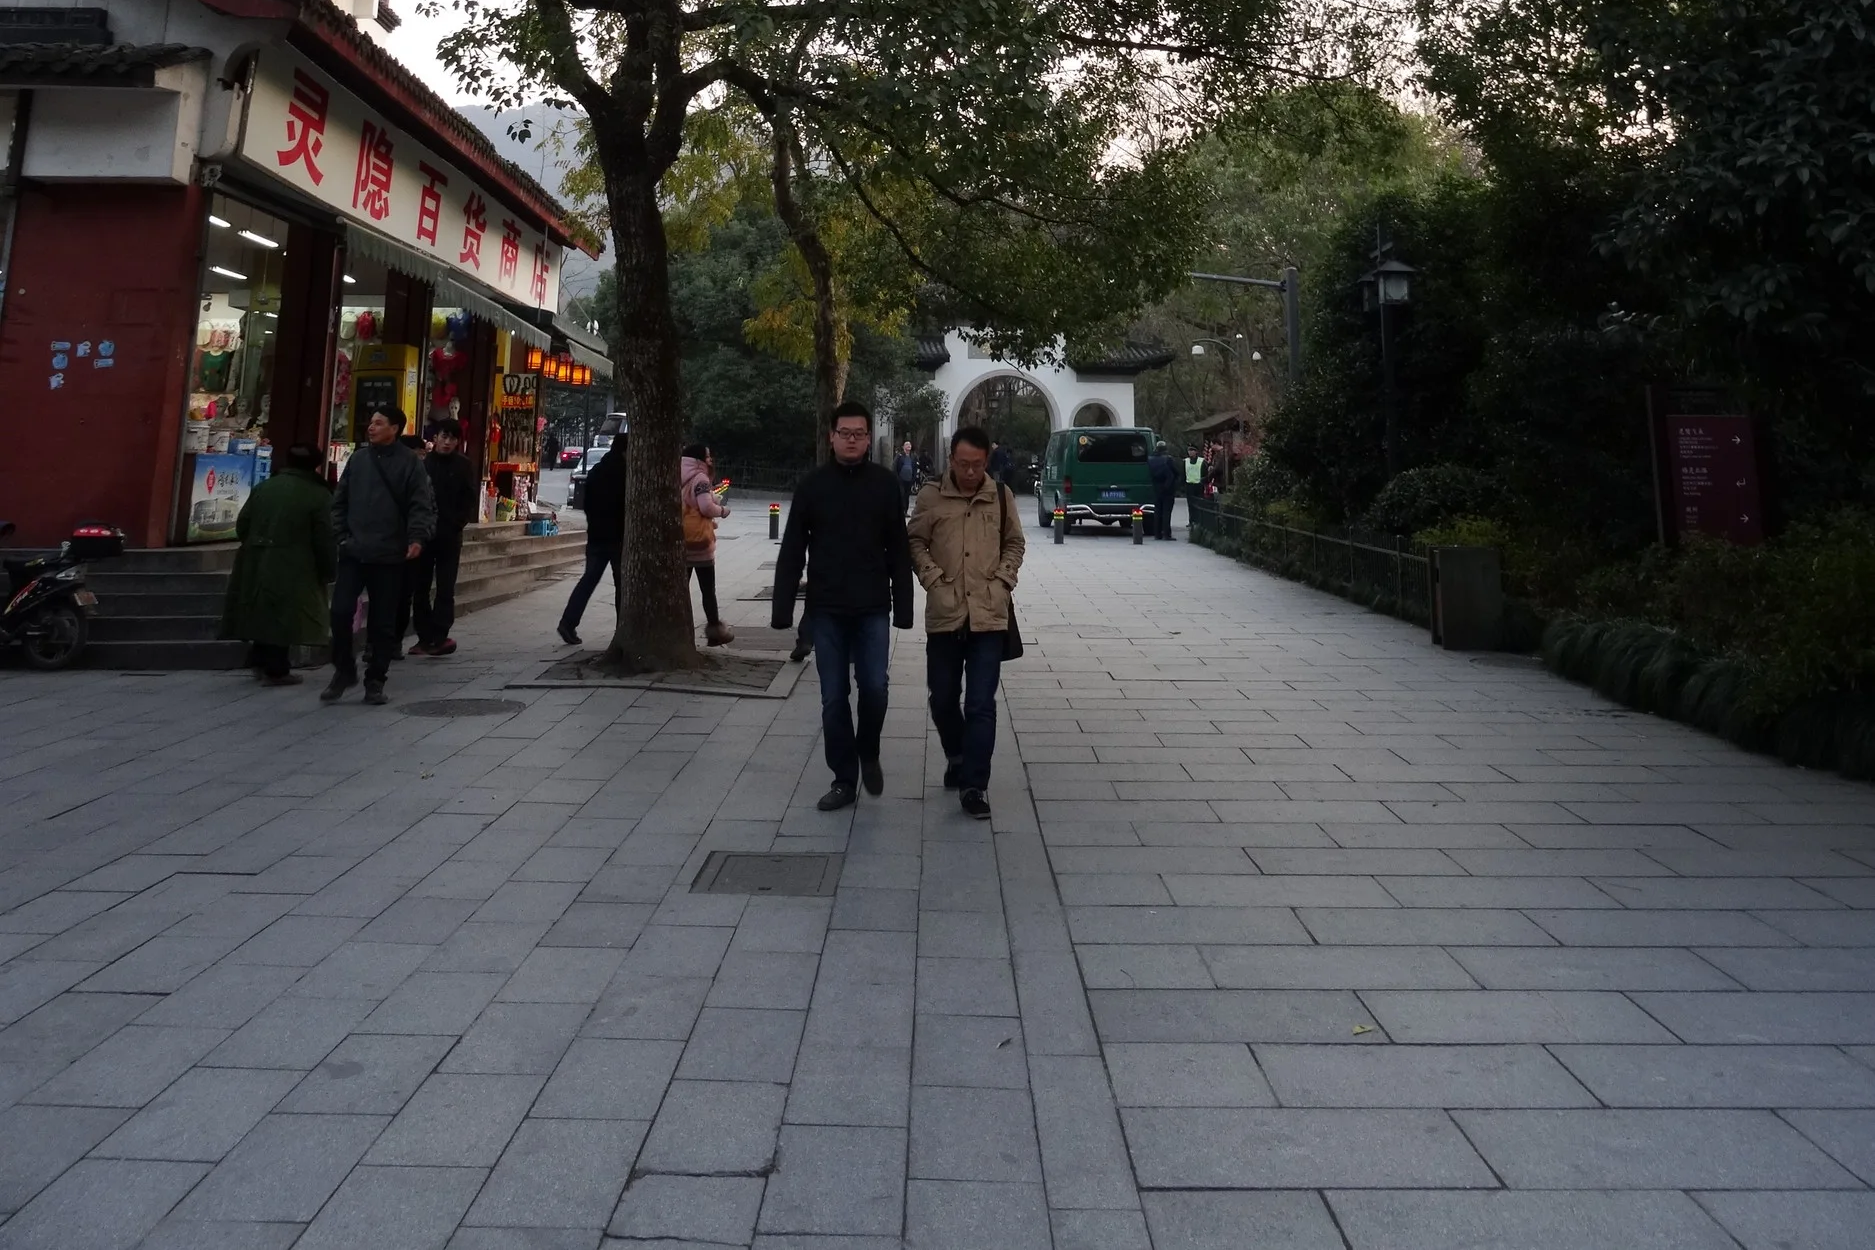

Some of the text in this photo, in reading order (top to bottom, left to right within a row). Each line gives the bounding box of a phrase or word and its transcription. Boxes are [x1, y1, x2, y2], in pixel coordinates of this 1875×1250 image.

[277, 66, 550, 306] 灵隐百货商店
